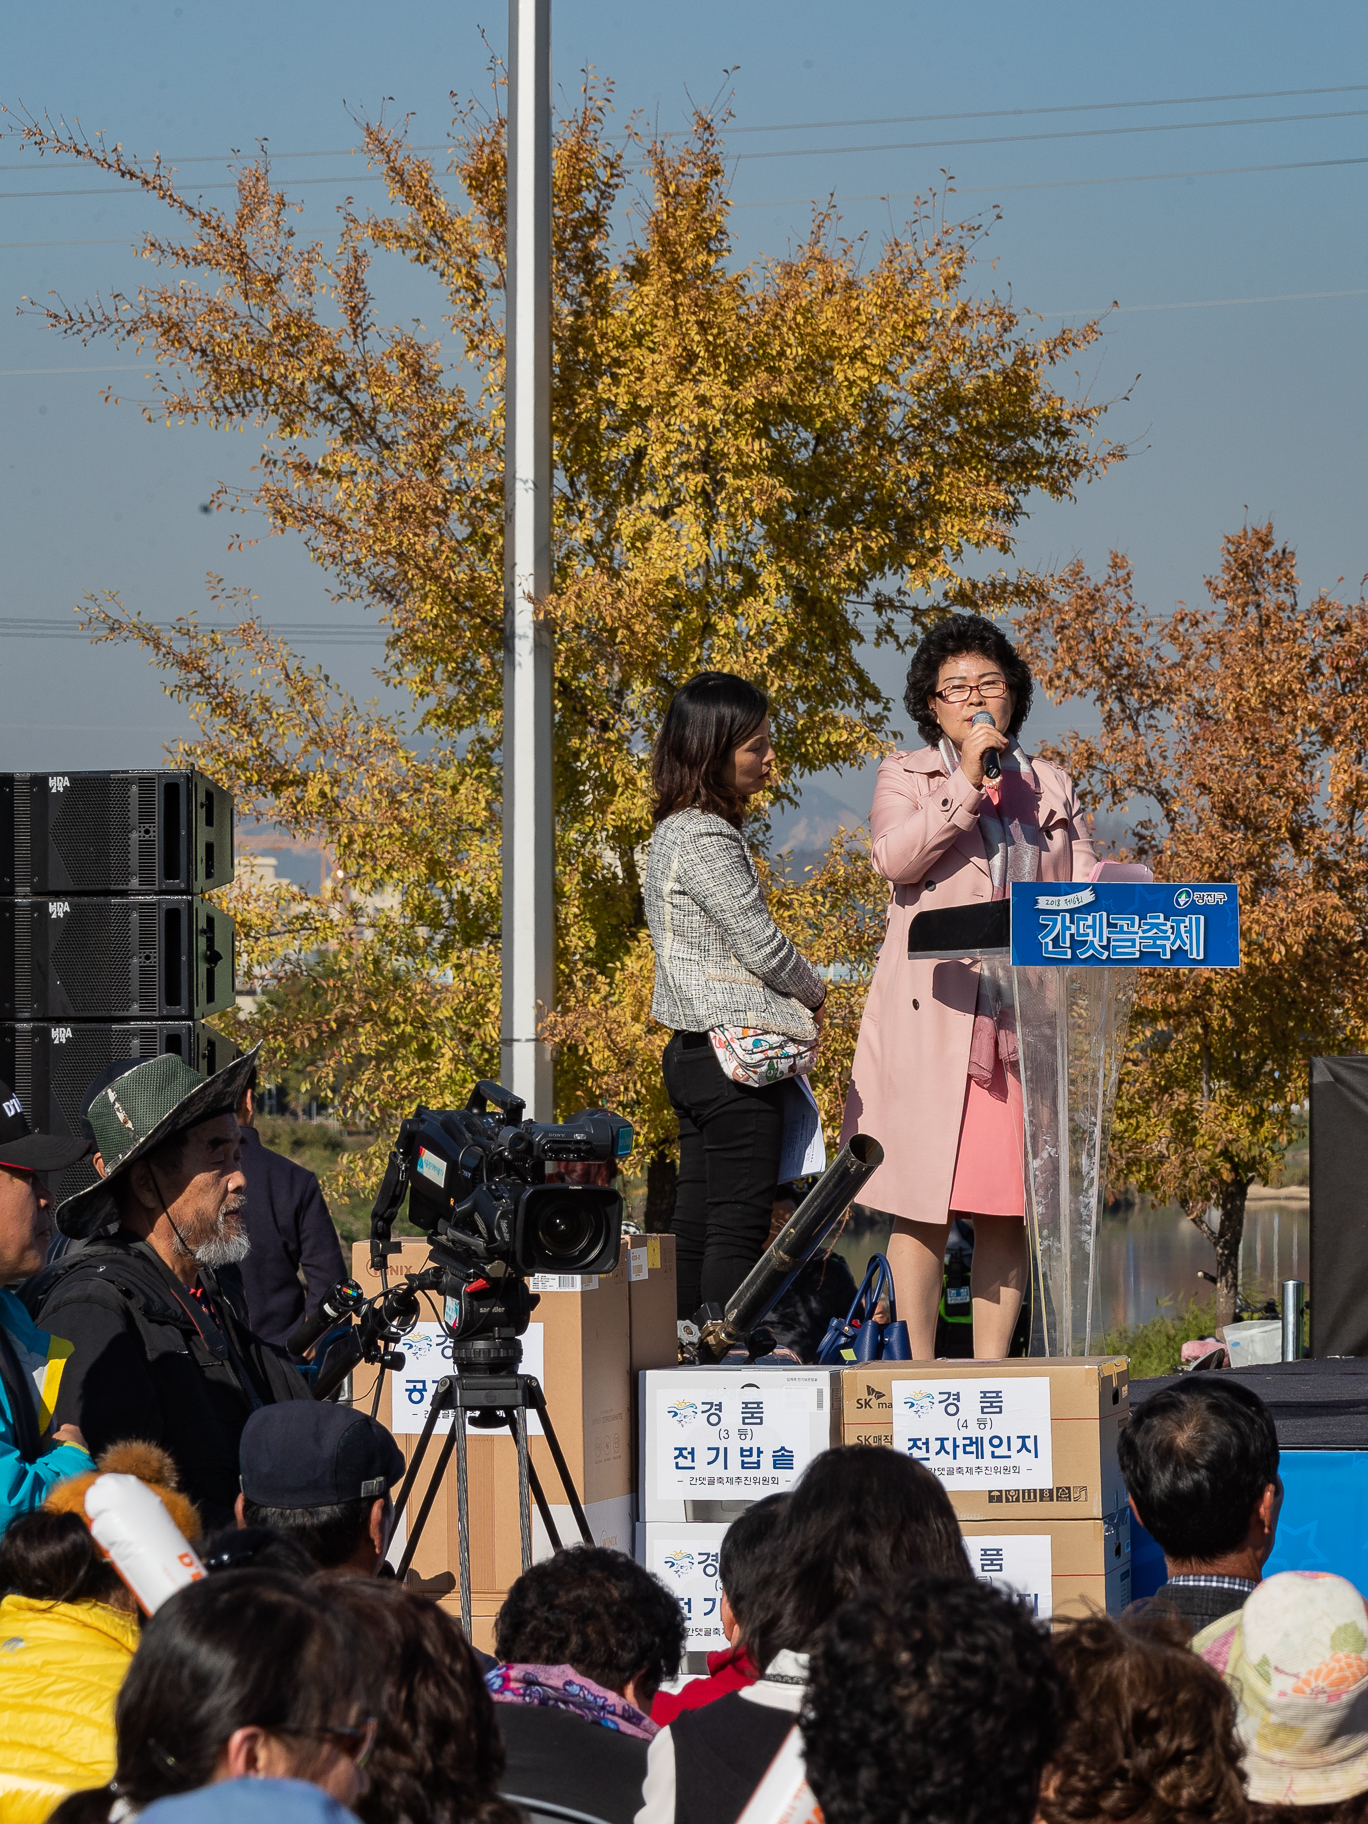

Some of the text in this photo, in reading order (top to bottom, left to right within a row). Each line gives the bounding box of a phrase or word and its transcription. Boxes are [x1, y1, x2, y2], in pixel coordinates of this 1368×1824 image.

[1045, 899, 1061, 907] 2018
[1194, 892, 1228, 905] 광진구
[1038, 911, 1205, 960] 간뎃골축제
[856, 1398, 873, 1409] SK
[907, 1435, 1039, 1461] 전자레인지
[689, 1476, 779, 1486] 간뎃골축제추진위원회
